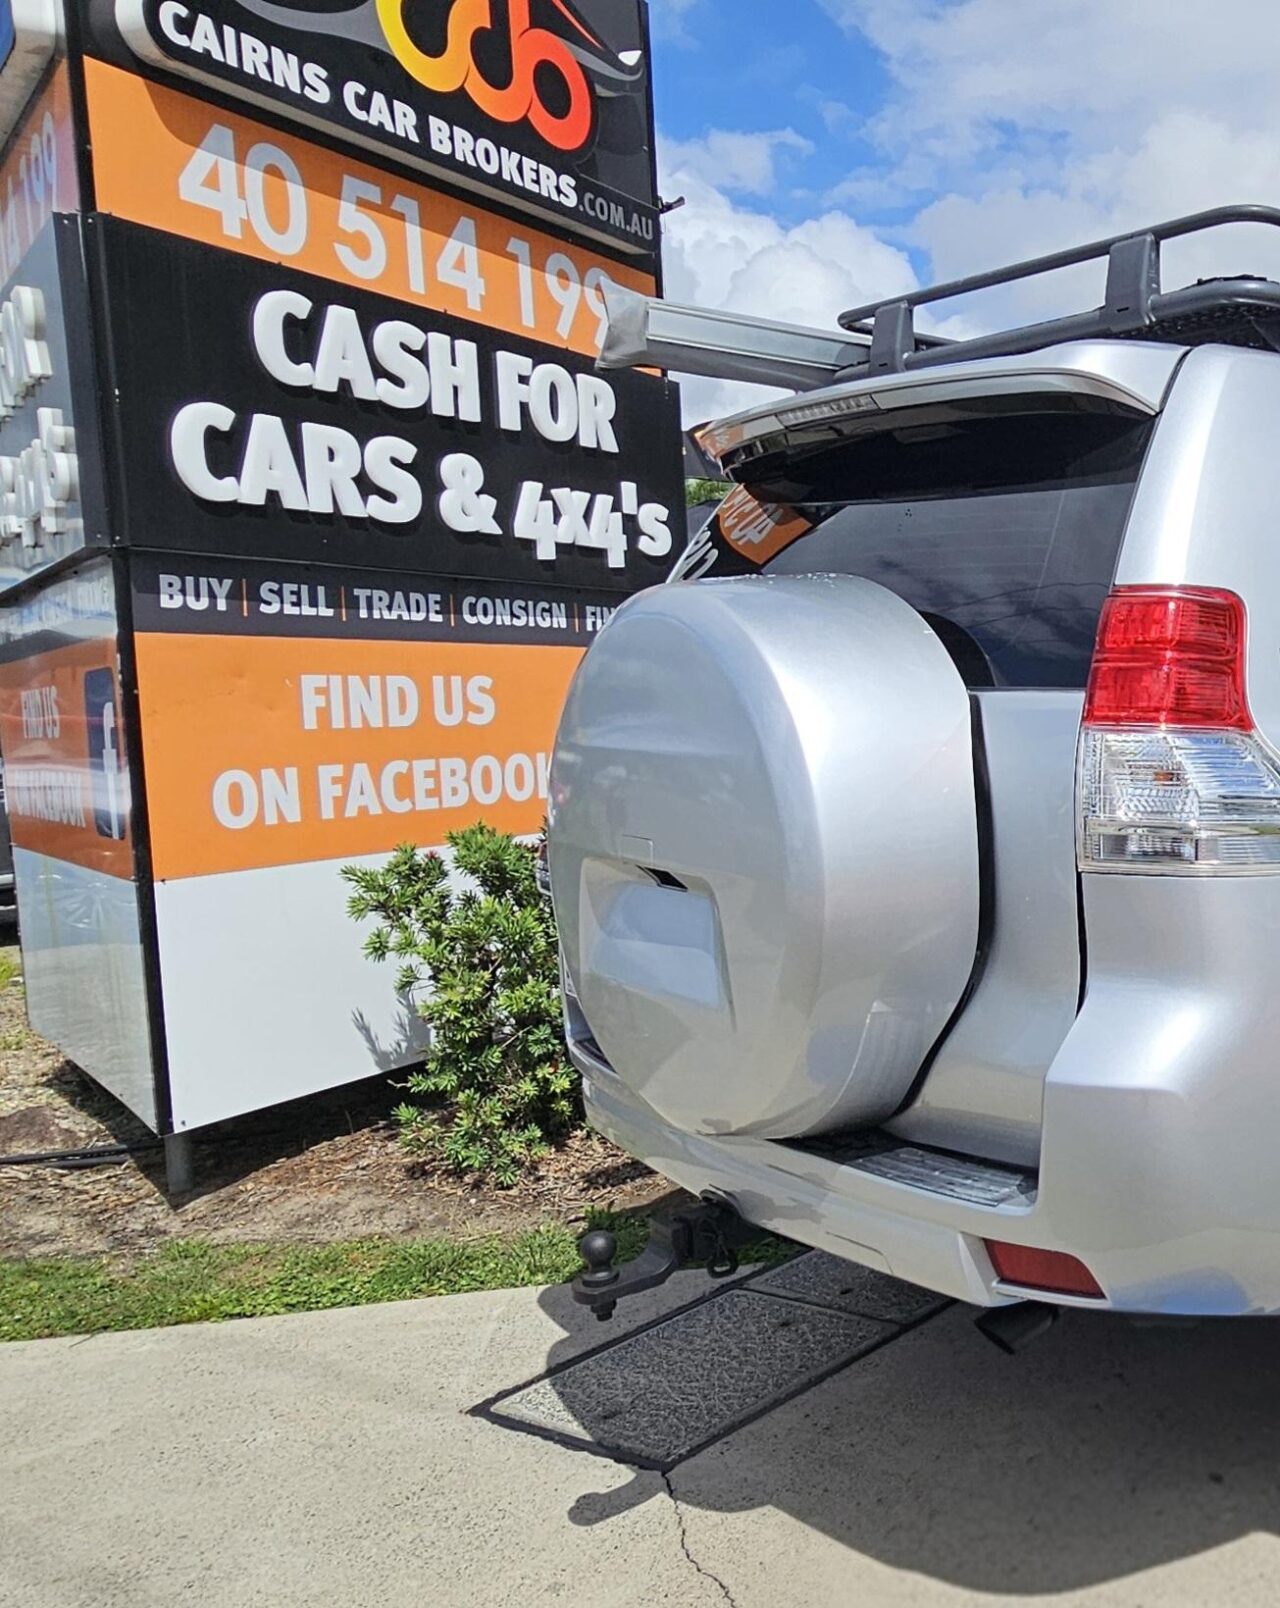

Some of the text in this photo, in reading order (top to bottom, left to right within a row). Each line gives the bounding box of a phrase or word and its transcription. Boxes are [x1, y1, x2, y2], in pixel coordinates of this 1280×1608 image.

[158, 0, 331, 104] CAIRNS
[343, 81, 420, 143] CAR
[179, 123, 307, 257] 40
[333, 174, 486, 312] 514
[253, 290, 619, 453] CASH FOR
[171, 402, 423, 523] CARS
[439, 453, 502, 535] &
[158, 574, 234, 612] BUY
[258, 581, 335, 618] SELL
[353, 588, 443, 623] TRADE
[461, 595, 568, 630] CONSIGN
[300, 674, 496, 730] FIND US
[211, 765, 302, 830] ON
